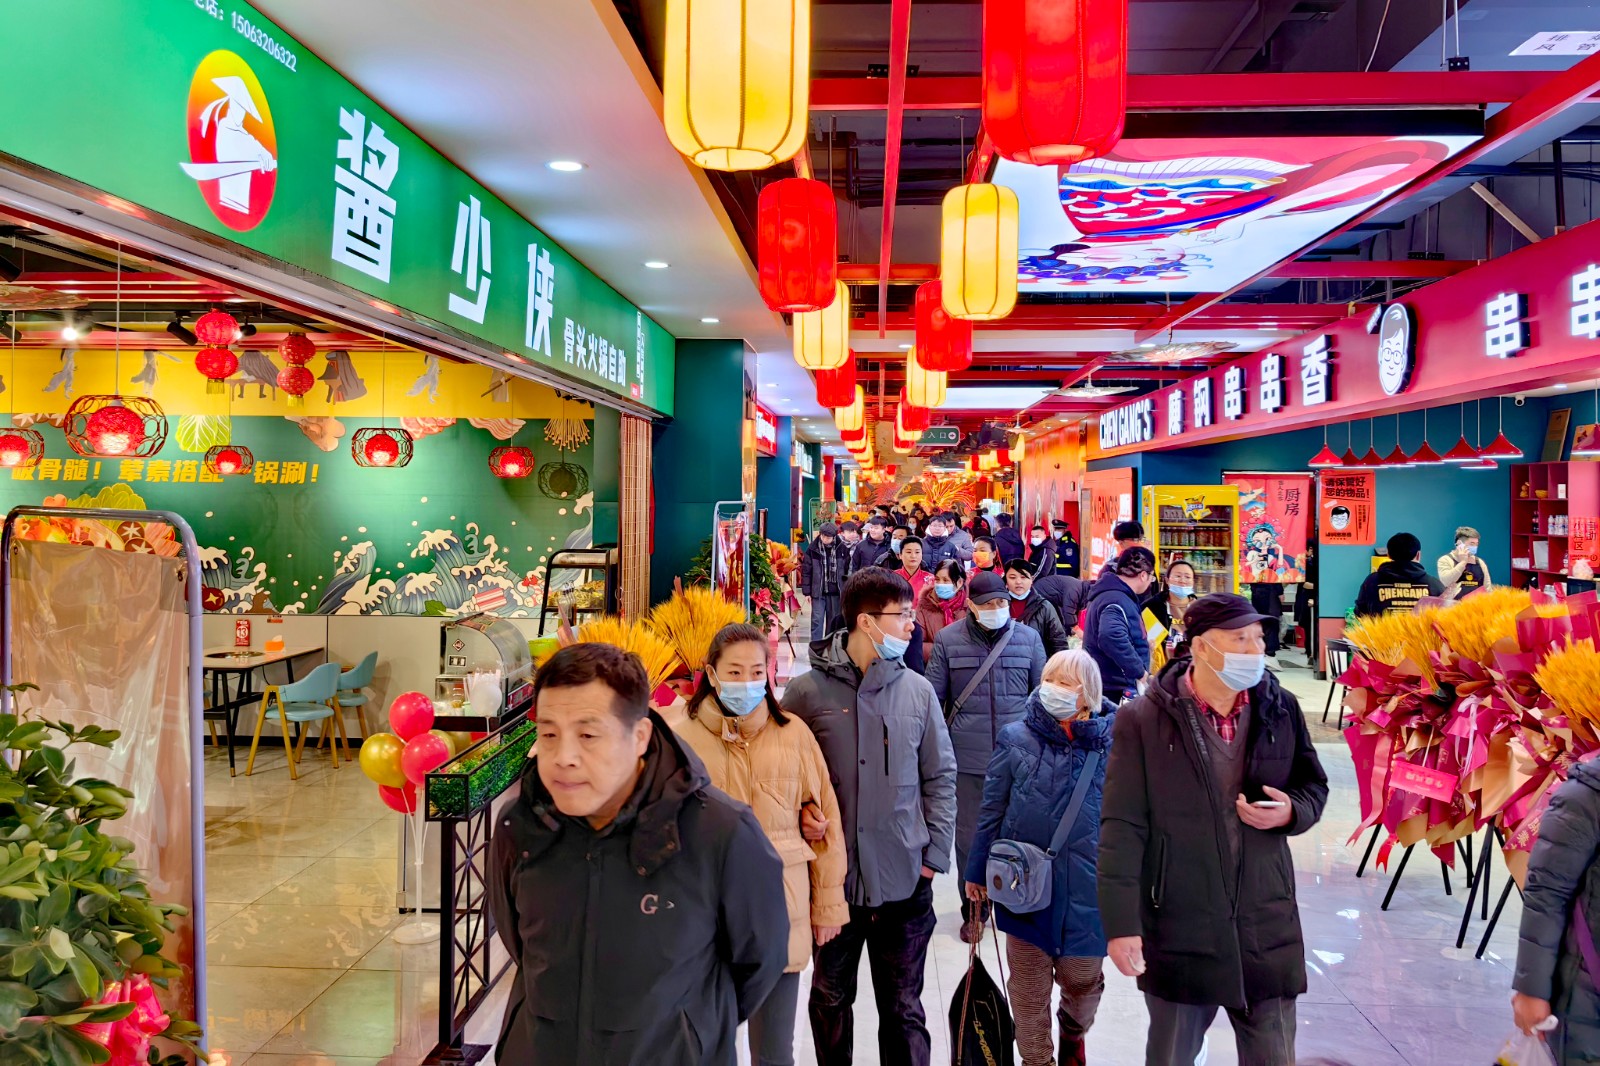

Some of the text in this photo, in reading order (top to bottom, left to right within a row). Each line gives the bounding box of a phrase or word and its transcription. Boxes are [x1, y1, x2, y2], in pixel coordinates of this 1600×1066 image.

[231, 11, 297, 73] 15063206322
[564, 317, 626, 387] 骨头火锅自助
[1099, 408, 1119, 450] CHEN
[1285, 488, 1301, 516] 厨房
[1325, 487, 1370, 498] 您的物品！
